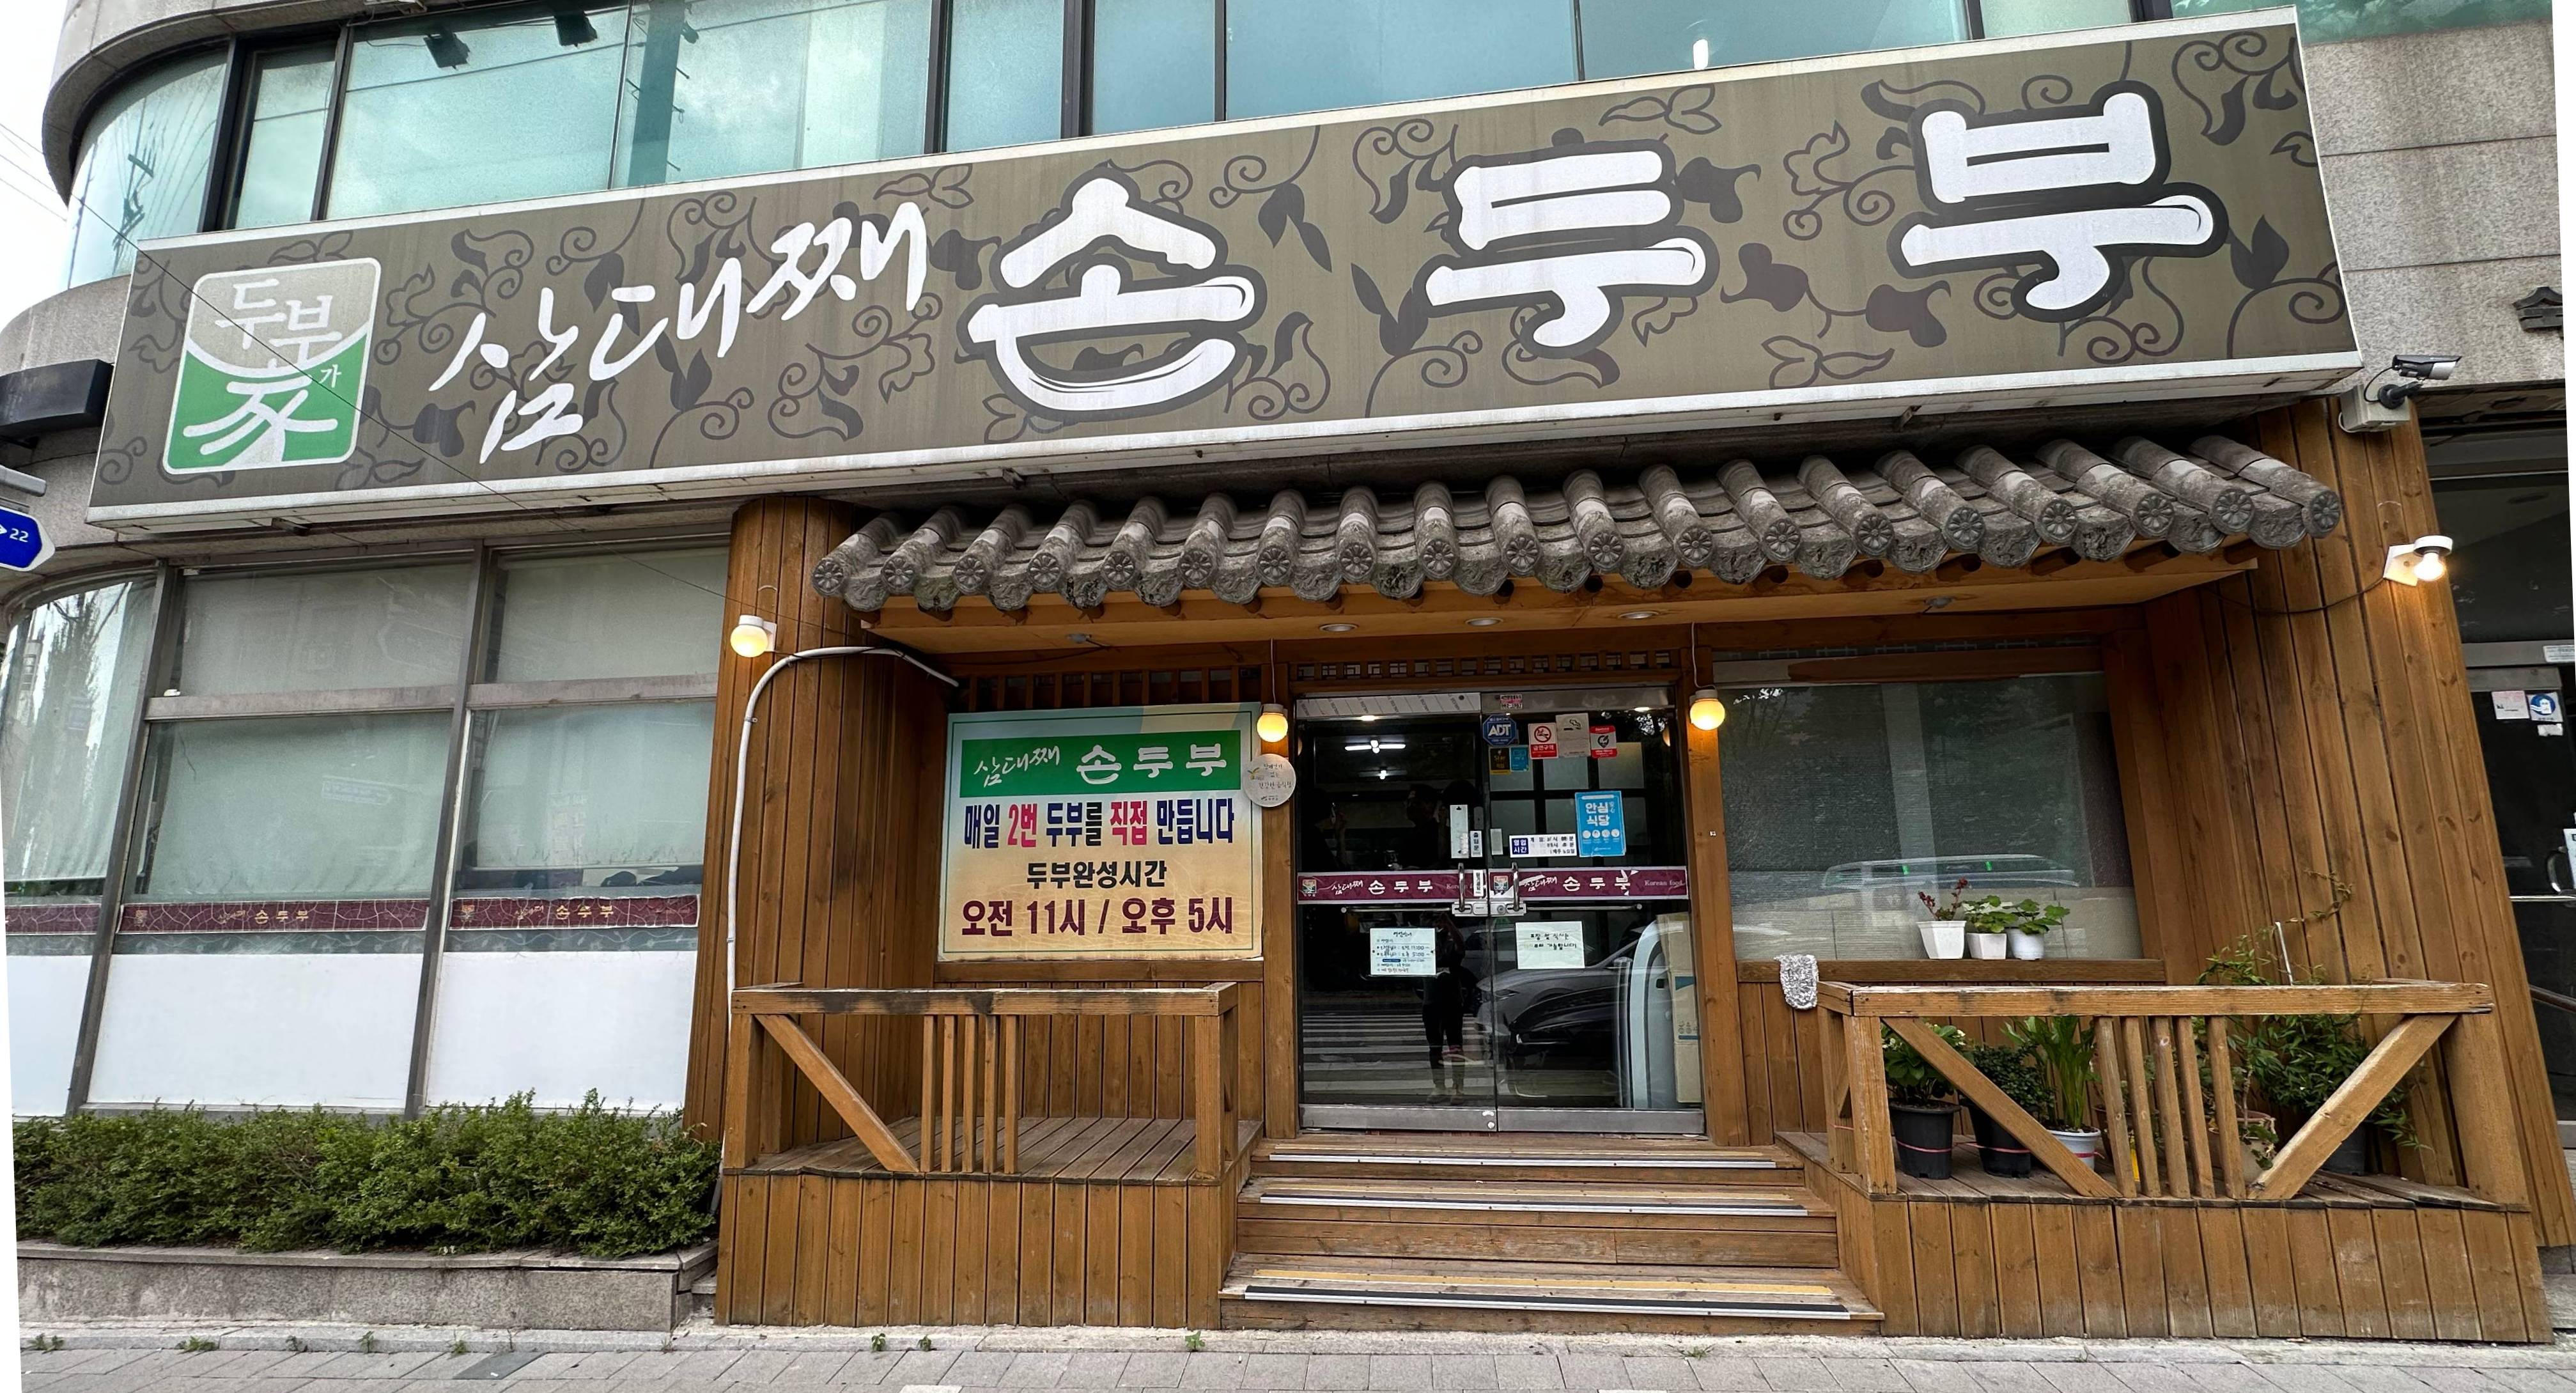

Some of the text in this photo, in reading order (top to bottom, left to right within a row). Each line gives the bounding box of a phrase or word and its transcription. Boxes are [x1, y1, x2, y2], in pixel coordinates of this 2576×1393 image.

[430, 91, 2217, 463] 삼대째 손두부
[215, 278, 342, 370] 두부
[319, 364, 343, 387] 가
[9, 527, 29, 543] 22
[1487, 724, 1511, 736] ADT
[974, 743, 1228, 788] 삼대째 손두부
[1585, 802, 1610, 814] 안심
[964, 797, 1235, 849] 매일 2번 두부를 직접 만듭니다
[1586, 814, 1610, 827] 식당
[1026, 860, 1168, 890] 두부완성시간
[1368, 879, 1434, 896] 손두부
[1562, 876, 1631, 892] 손두부
[254, 908, 309, 924] 손두부
[555, 904, 614, 921] 손두부
[961, 896, 1234, 936] 오전 11시 / 오후 5시
